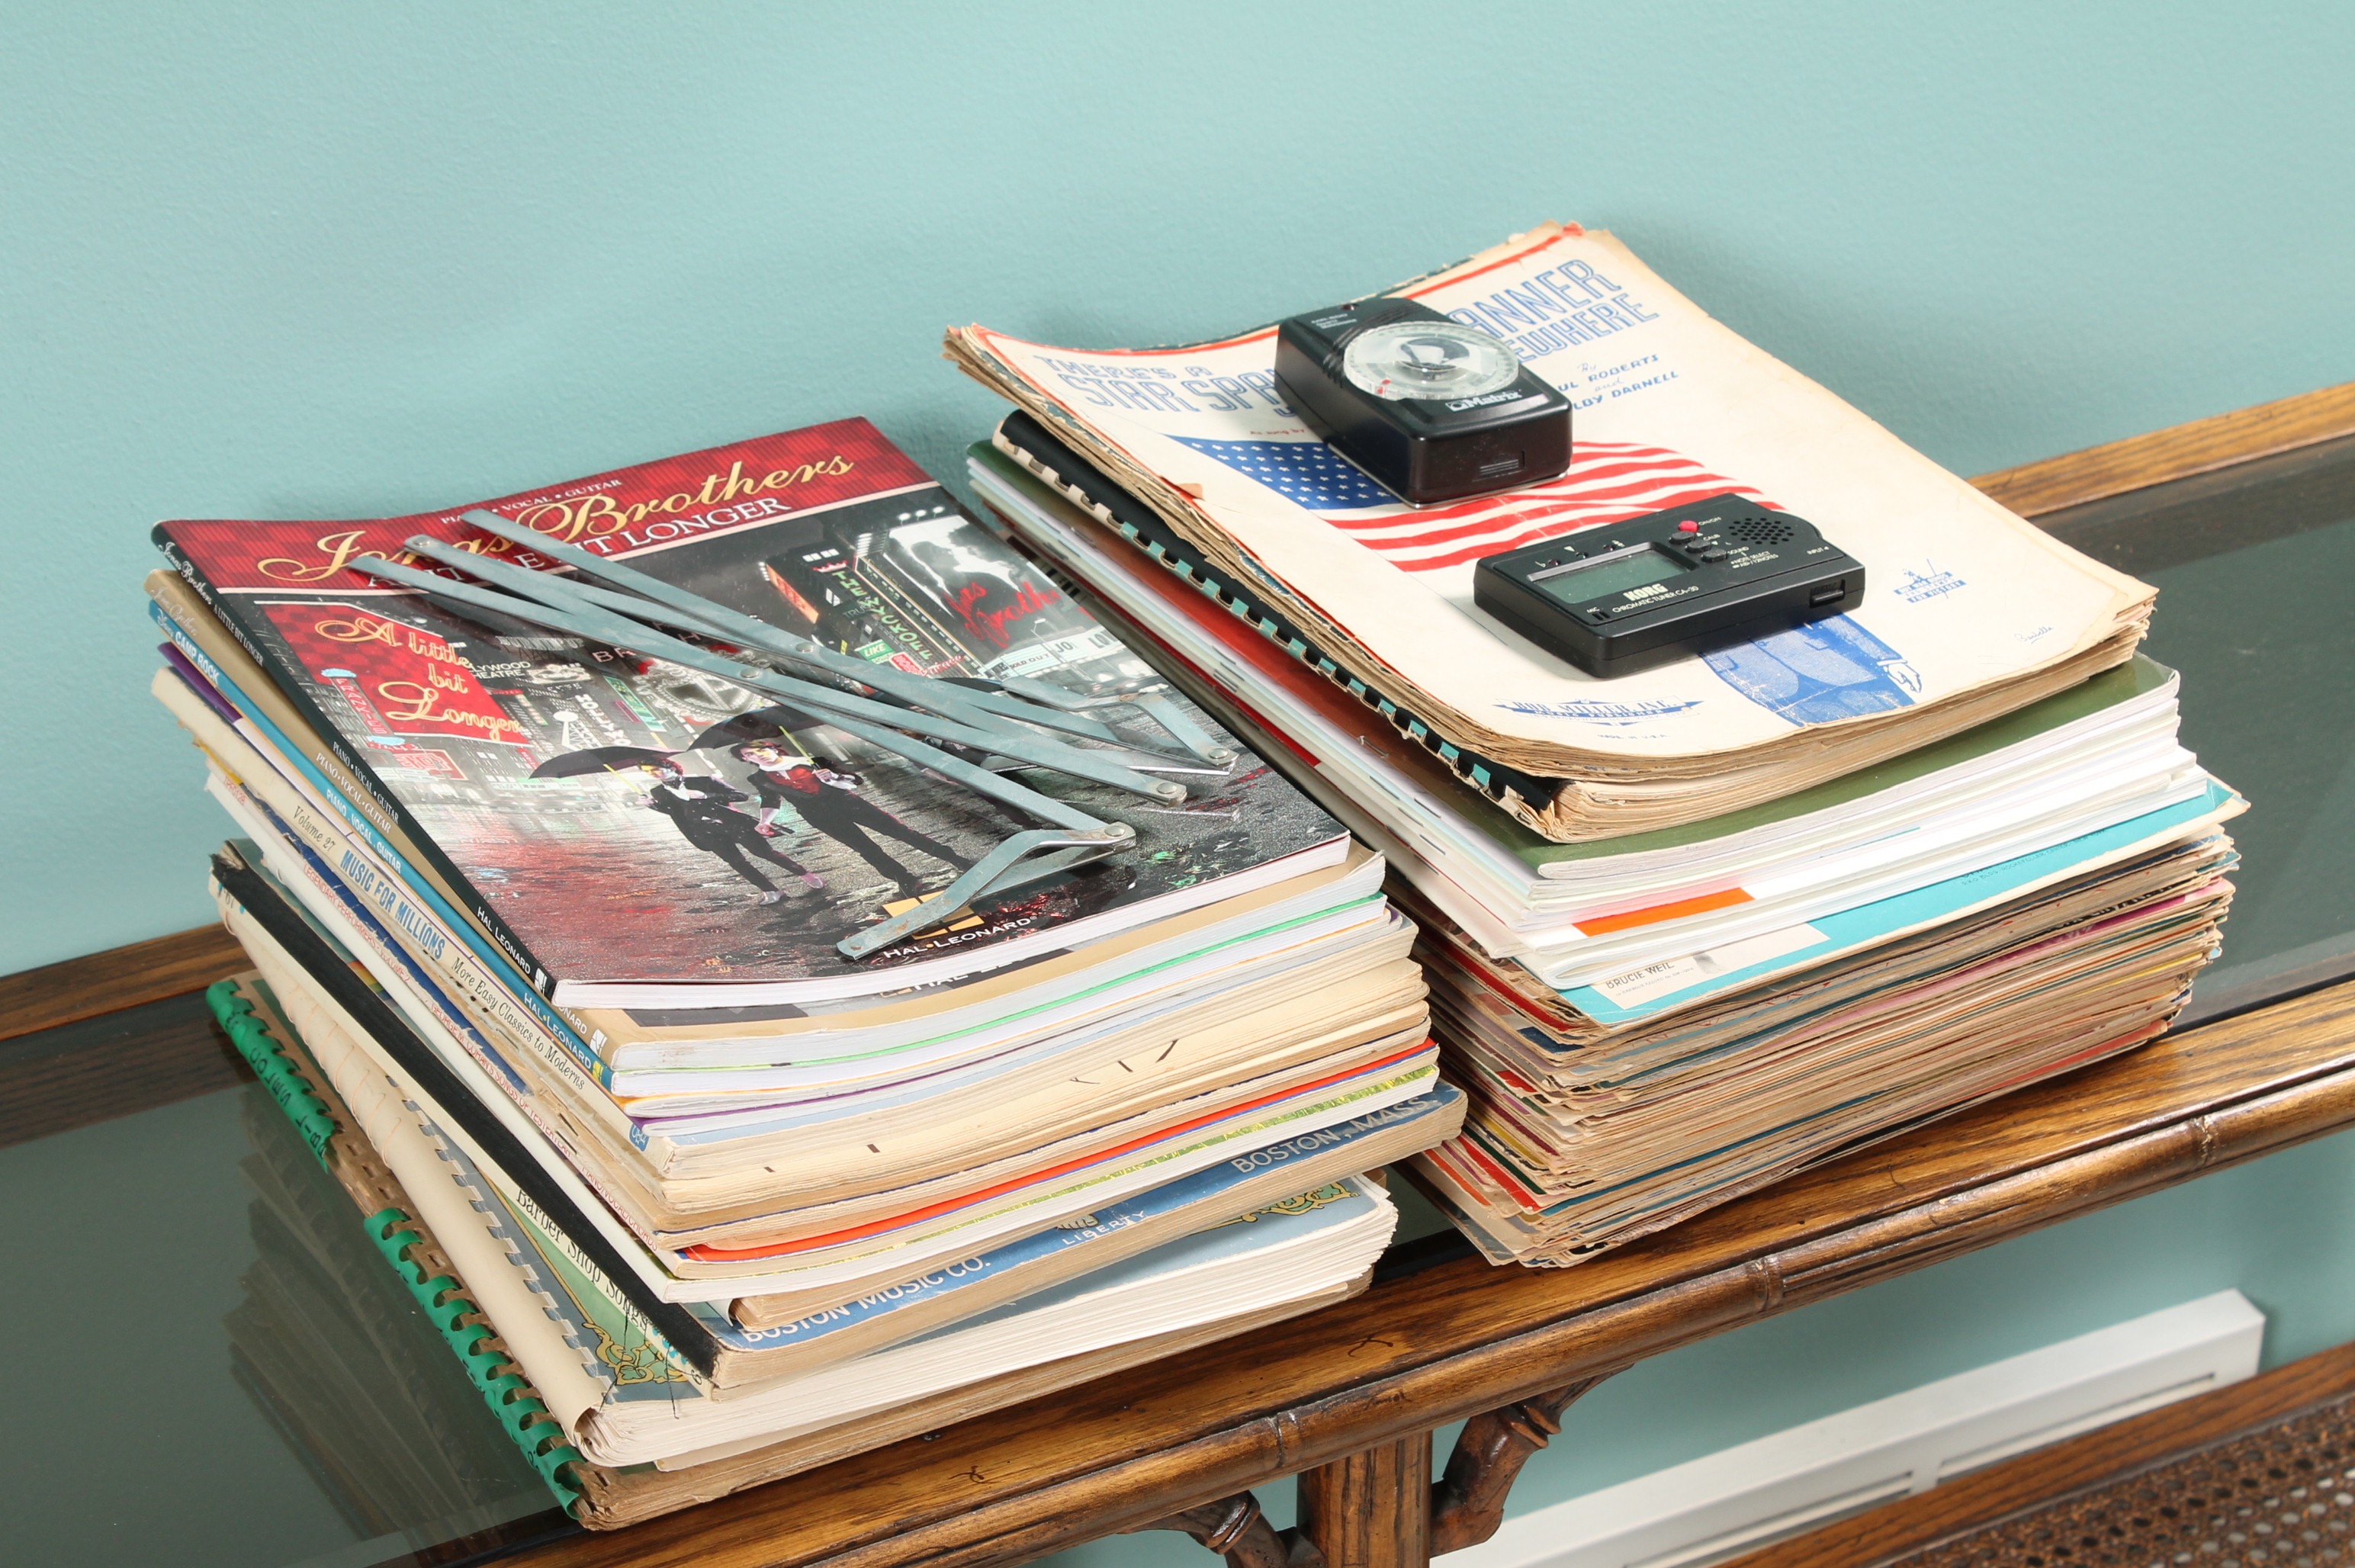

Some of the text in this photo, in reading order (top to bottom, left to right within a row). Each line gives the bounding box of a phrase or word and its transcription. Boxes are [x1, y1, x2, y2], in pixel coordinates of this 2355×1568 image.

[1446, 259, 1623, 341] ANNER
[1505, 294, 1660, 363] EWHERE
[1033, 355, 1214, 381] THERE'S A
[1558, 354, 1659, 392] UL ROBERTS
[1058, 374, 1200, 413] STAR
[1461, 390, 1523, 409] Matrix
[1573, 371, 1679, 410] LBY DARNELL
[501, 496, 552, 512] VOCAL
[564, 478, 622, 498] GUITAR
[516, 455, 854, 544] Brothers
[619, 497, 792, 548] LONGER
[1727, 546, 1749, 555] SOUND
[1611, 585, 1699, 613] CHROMATIC TUNER CA-30
[1623, 583, 1669, 602] KORG
[217, 607, 235, 633] LITTLE
[234, 628, 245, 644] BIT
[243, 638, 265, 667] LONGER
[408, 632, 473, 667] little
[864, 643, 886, 657] LIKE
[175, 631, 197, 658] CAMP
[197, 652, 221, 686] ROCK
[428, 663, 468, 694] bit
[1009, 653, 1050, 670] SOLD OUT
[378, 681, 525, 741] Longer
[316, 752, 392, 834] PIANO VOCAL GUITAR
[333, 741, 399, 824] PIANO VOCAL GUITAR
[293, 805, 336, 852] Volume 27
[326, 788, 402, 874] PIANO VOCAL GUITAR
[339, 849, 445, 959] MUSIC FOR MILLIONS
[477, 906, 532, 975] HAL LEONARD
[883, 917, 1032, 959] HAL LEONARD
[1605, 971, 1645, 989] BRUCIE
[1645, 962, 1675, 975] WEIL
[451, 956, 585, 1091] More Easy Classics to Moderns
[524, 992, 592, 1070] HAL LEONARD
[558, 1005, 587, 1035] ONARD
[494, 1072, 518, 1100] SONGS
[519, 1094, 529, 1110] OF
[1351, 1096, 1438, 1133] MASS.
[1062, 1210, 1148, 1247] LIBERTY
[516, 1188, 648, 1331] Barber Shop Songs
[857, 1274, 945, 1311] MUSIC
[945, 1255, 992, 1279] CO.
